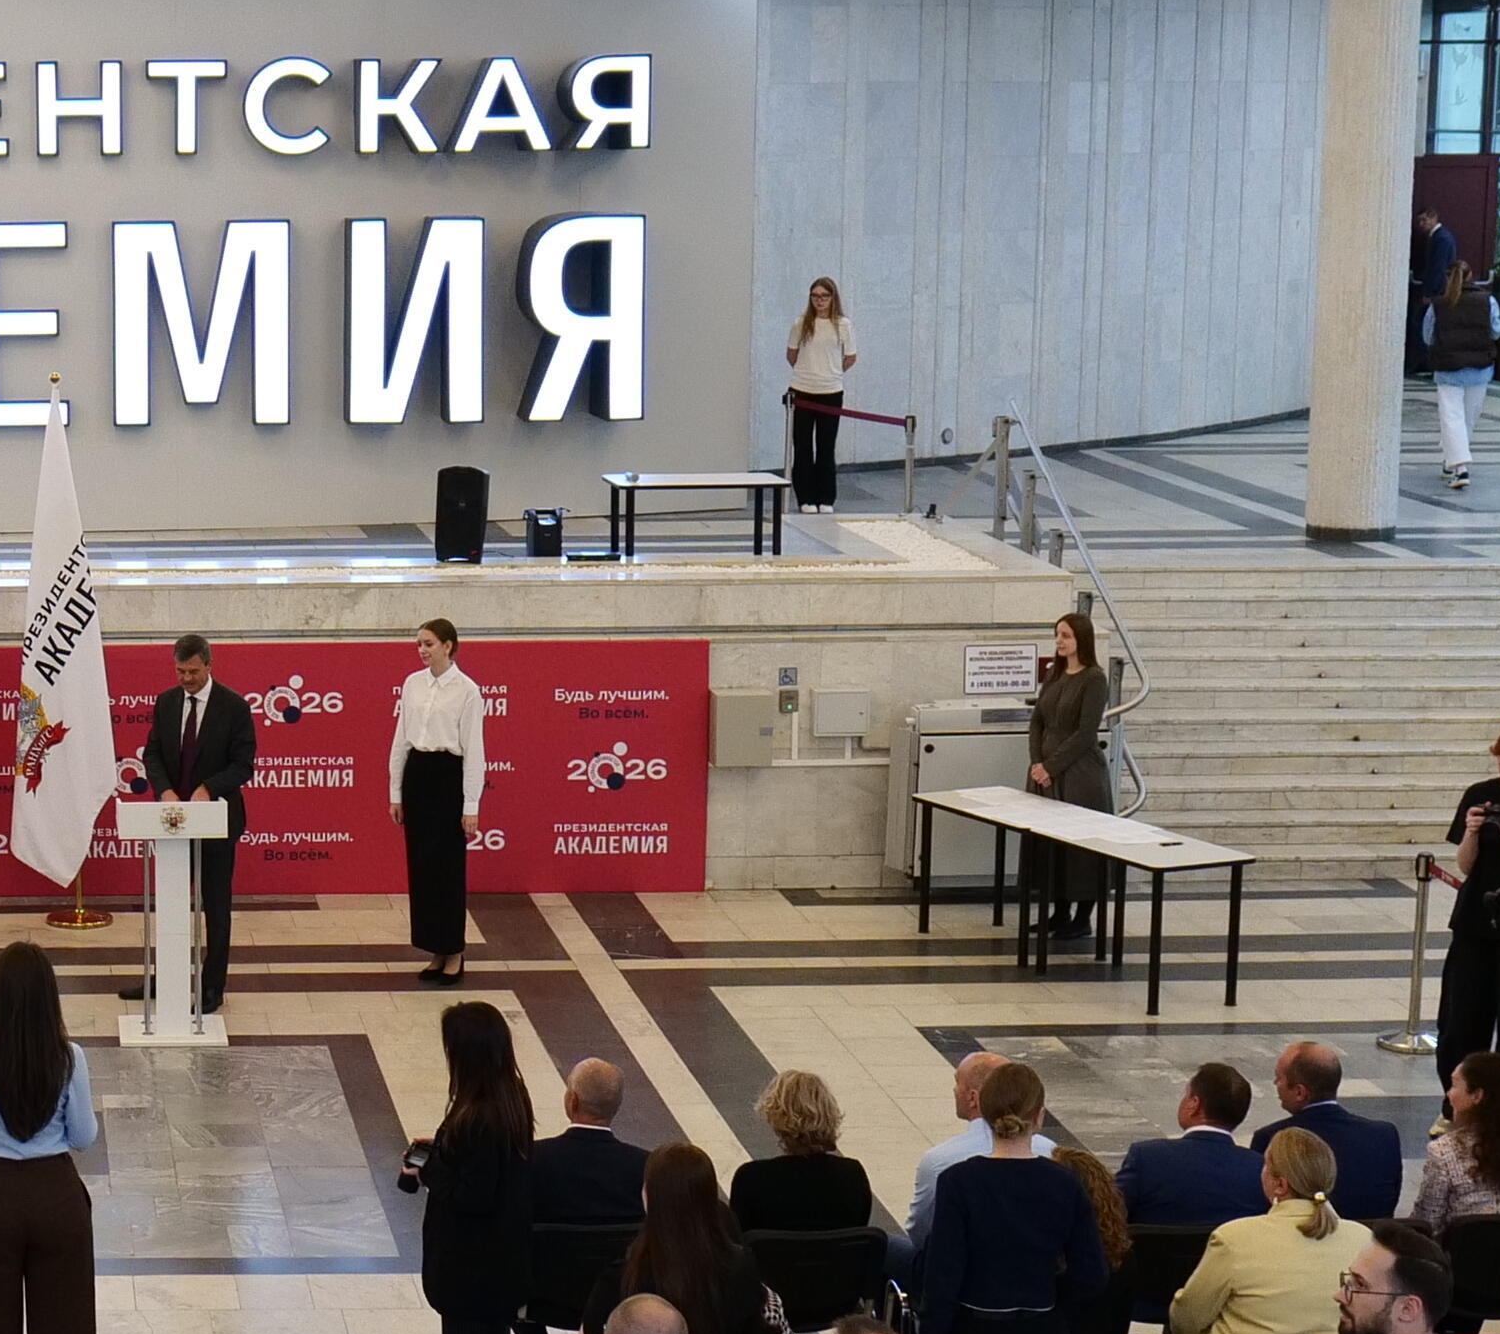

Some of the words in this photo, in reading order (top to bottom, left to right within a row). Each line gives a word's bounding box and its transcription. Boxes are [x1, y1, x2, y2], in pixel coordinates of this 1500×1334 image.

[34, 568, 97, 687] АКАДЕ
[554, 689, 593, 703] Будь
[597, 690, 669, 703] лучшим.
[579, 708, 599, 719] Во
[254, 757, 353, 766] ЕЗИДЕНТСКАЯ
[567, 753, 668, 789] 2026
[554, 824, 668, 833] ПРЕЗИДЕНТСКАЯ
[240, 831, 278, 844] Будь
[282, 831, 354, 845] лучшим.
[554, 836, 668, 854] АКАДЕМИЯ
[263, 849, 284, 861] Во
[289, 847, 333, 861] всём.
